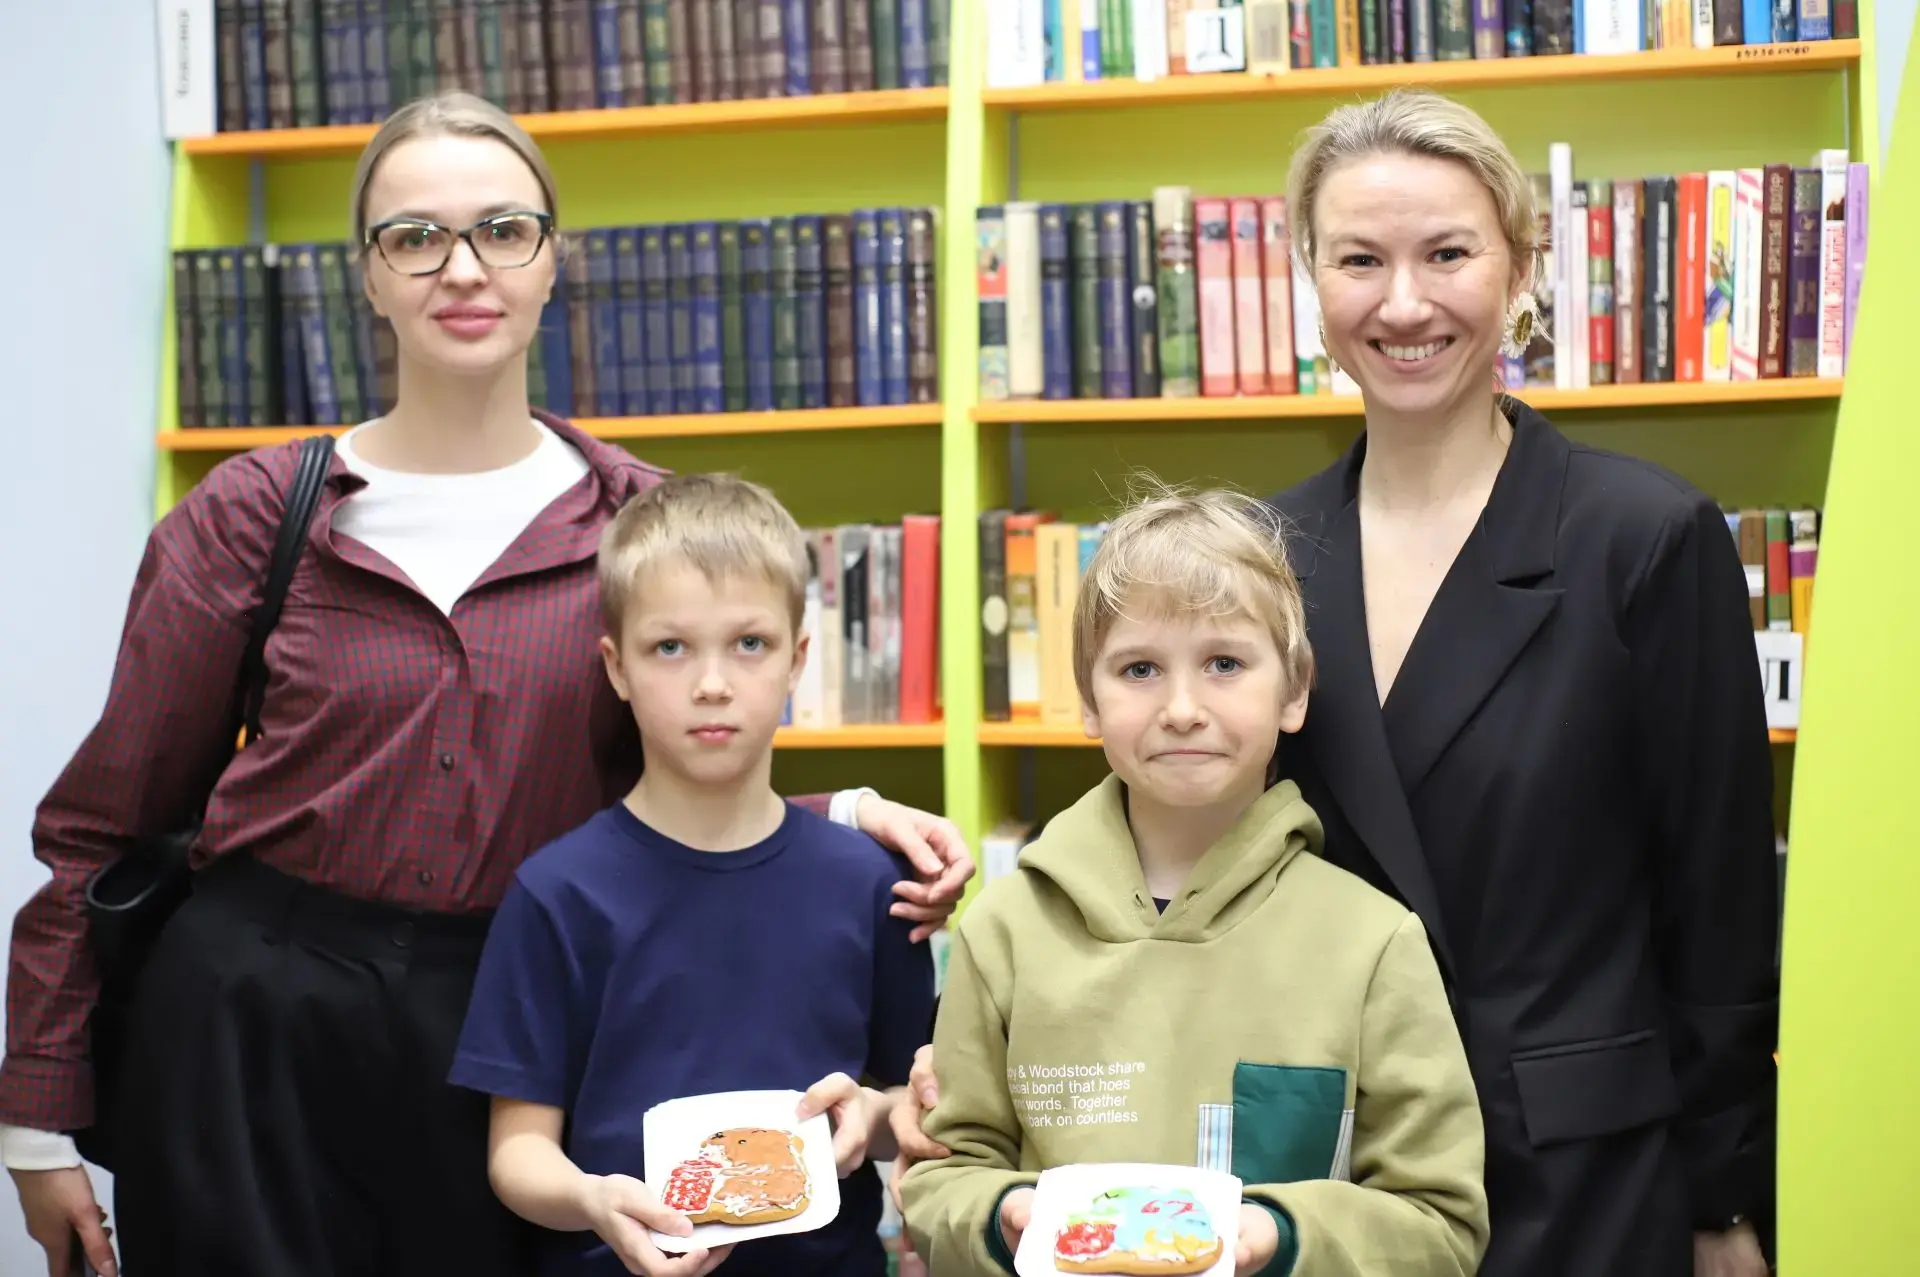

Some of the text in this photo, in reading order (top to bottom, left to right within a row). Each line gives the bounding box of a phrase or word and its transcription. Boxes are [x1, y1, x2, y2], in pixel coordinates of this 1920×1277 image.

[1018, 1064, 1026, 1079] &
[1028, 1062, 1105, 1079] Woodstock
[1108, 1061, 1146, 1075] share
[1032, 1080, 1064, 1095] bond
[1068, 1079, 1096, 1093] that
[1099, 1078, 1131, 1091] hoes
[1026, 1097, 1066, 1111] words.
[1070, 1094, 1128, 1112] Together
[1056, 1115, 1073, 1126] on
[1076, 1109, 1139, 1125] countless
